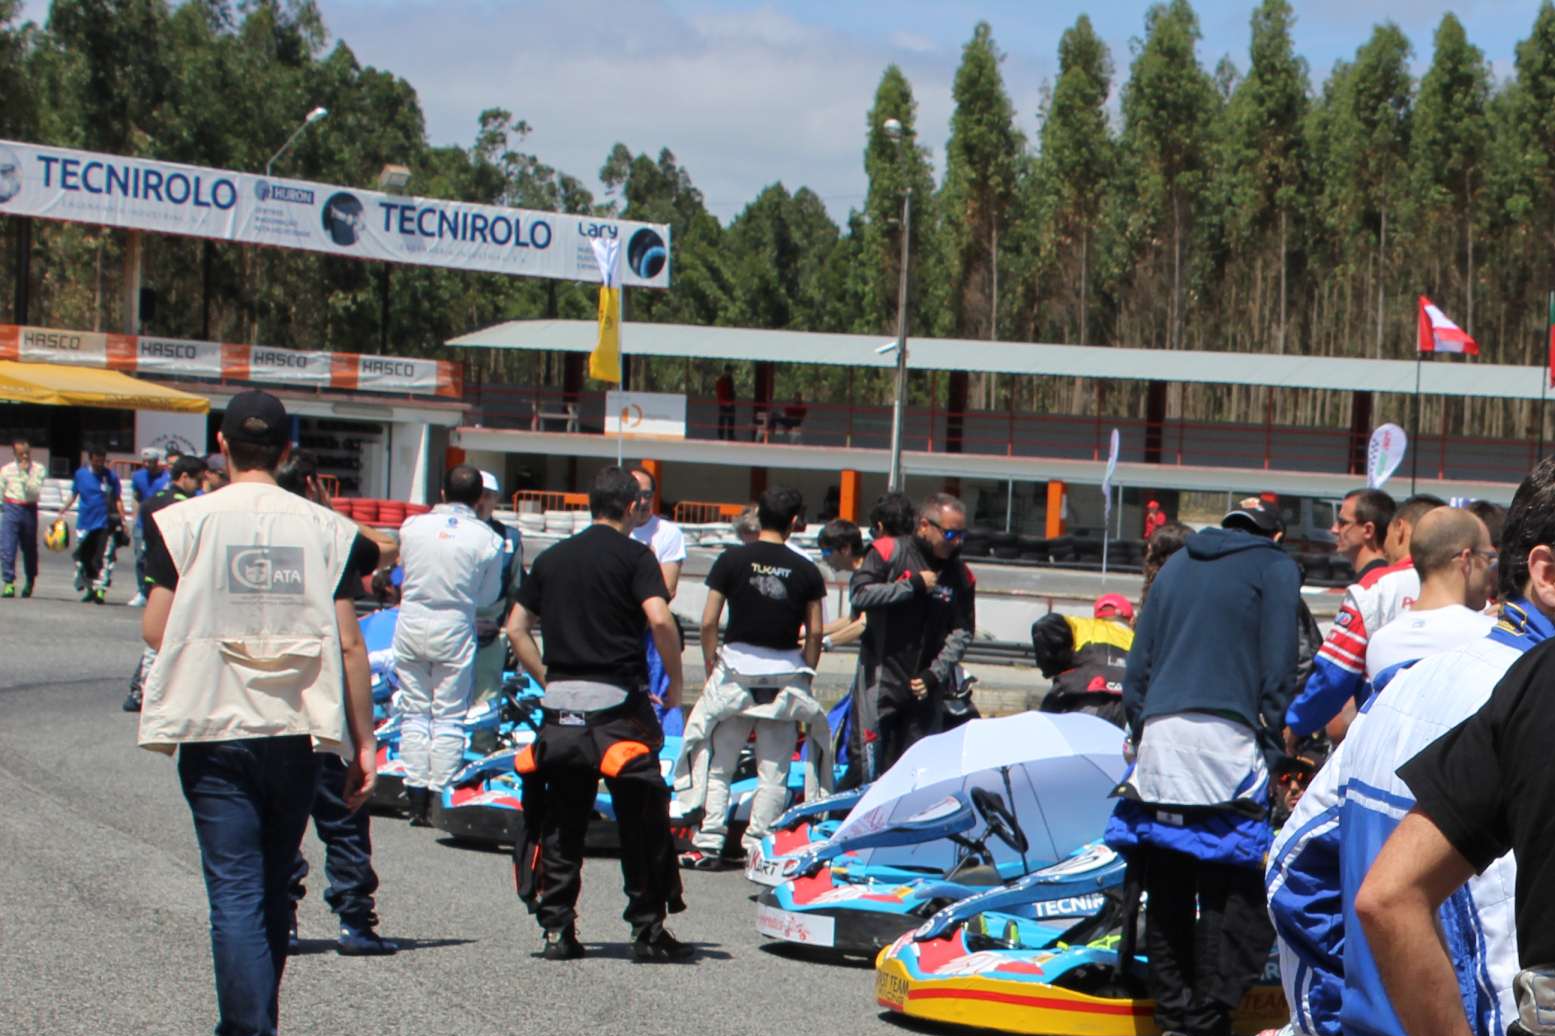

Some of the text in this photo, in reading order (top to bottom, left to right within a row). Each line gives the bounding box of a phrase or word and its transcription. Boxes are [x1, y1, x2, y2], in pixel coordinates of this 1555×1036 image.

[36, 154, 238, 211] TECNIROLO
[379, 201, 553, 250] TECNIROLO
[23, 332, 81, 351] HASCO
[140, 341, 197, 360] HASCO
[253, 350, 308, 369] HASCO
[361, 359, 415, 378] HASCO
